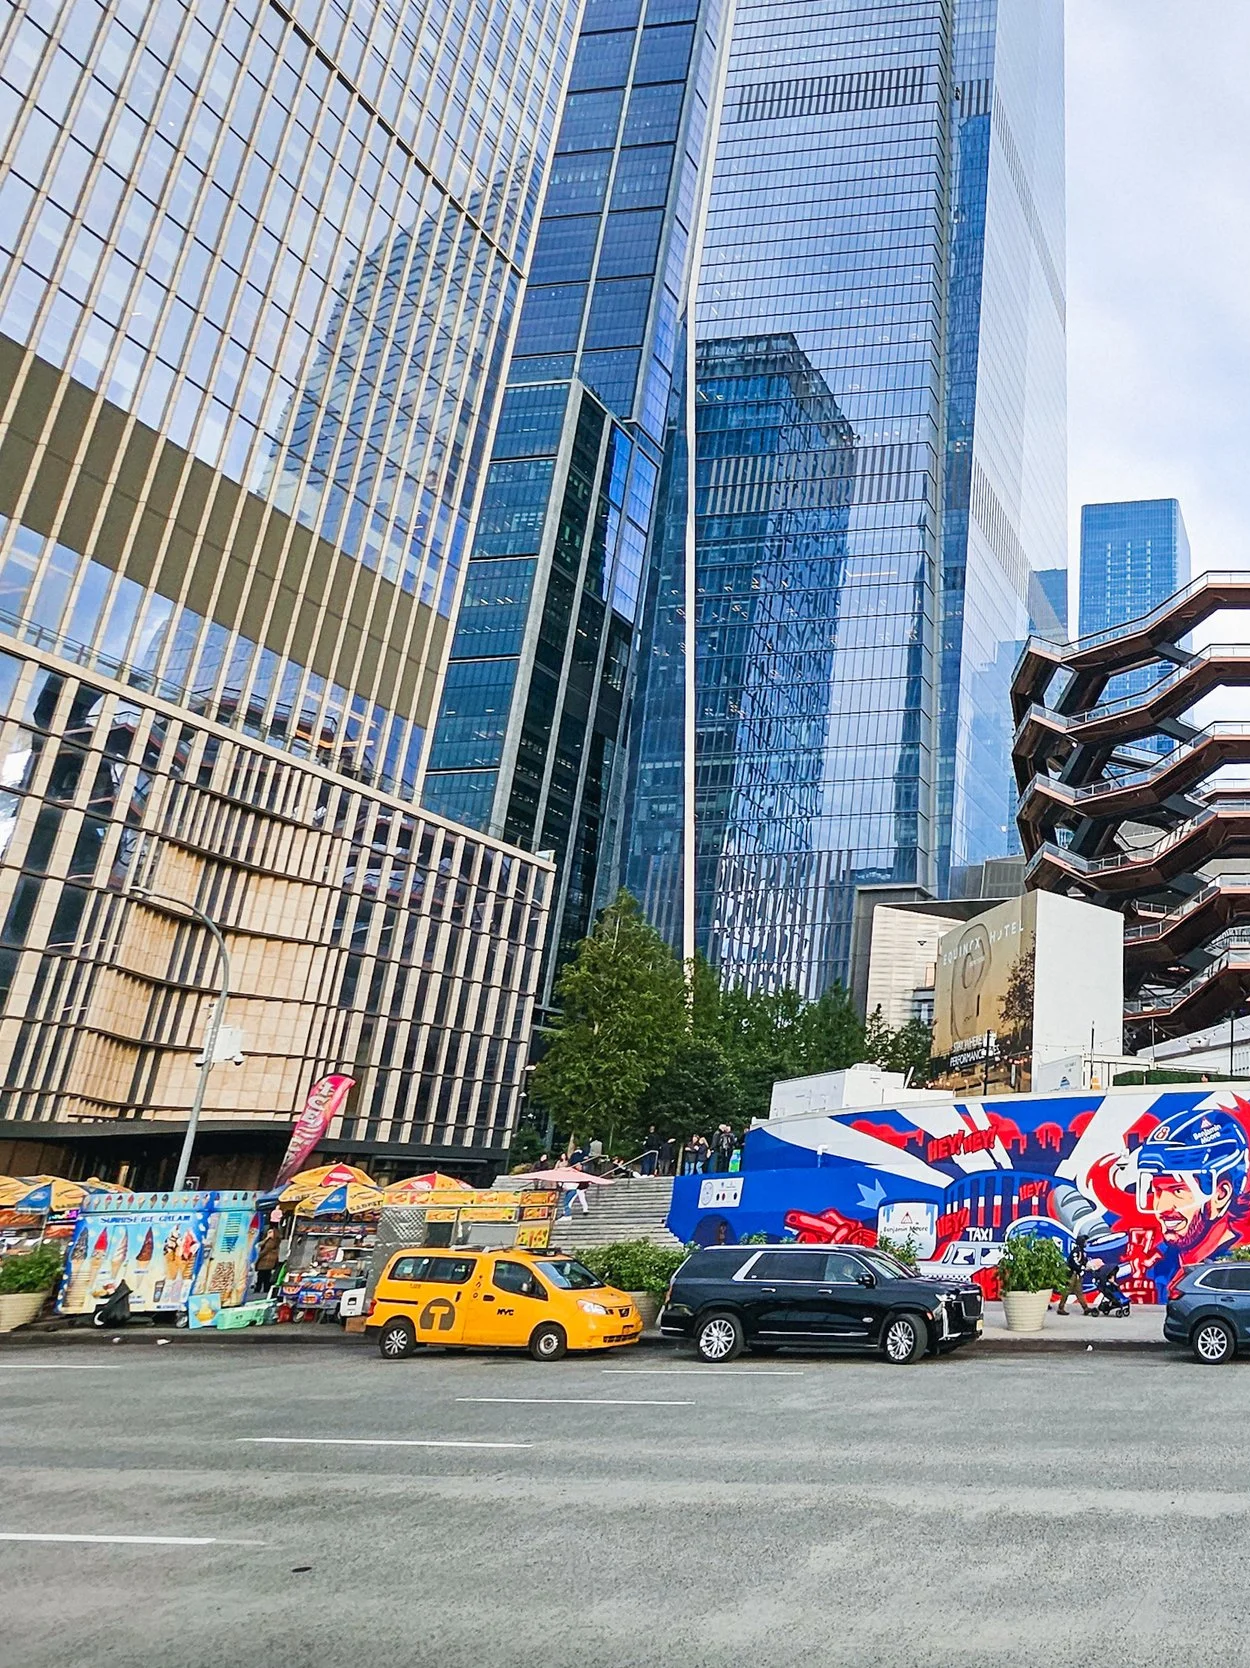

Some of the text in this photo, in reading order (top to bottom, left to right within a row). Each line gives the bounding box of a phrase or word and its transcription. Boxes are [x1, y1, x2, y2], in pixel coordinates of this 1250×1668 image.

[950, 1048, 987, 1067] PERFORMANC
[1155, 1127, 1169, 1141] 8
[1193, 1124, 1222, 1140] Benjamin
[1200, 1132, 1221, 1145] Moore
[927, 1126, 997, 1163] HEY! HEY!
[1019, 1180, 1048, 1201] HEY!
[883, 1224, 928, 1234] Benjamin Moore
[937, 1208, 969, 1238] HEY!
[966, 1227, 993, 1241] TAXI
[496, 1308, 515, 1316] NYC
